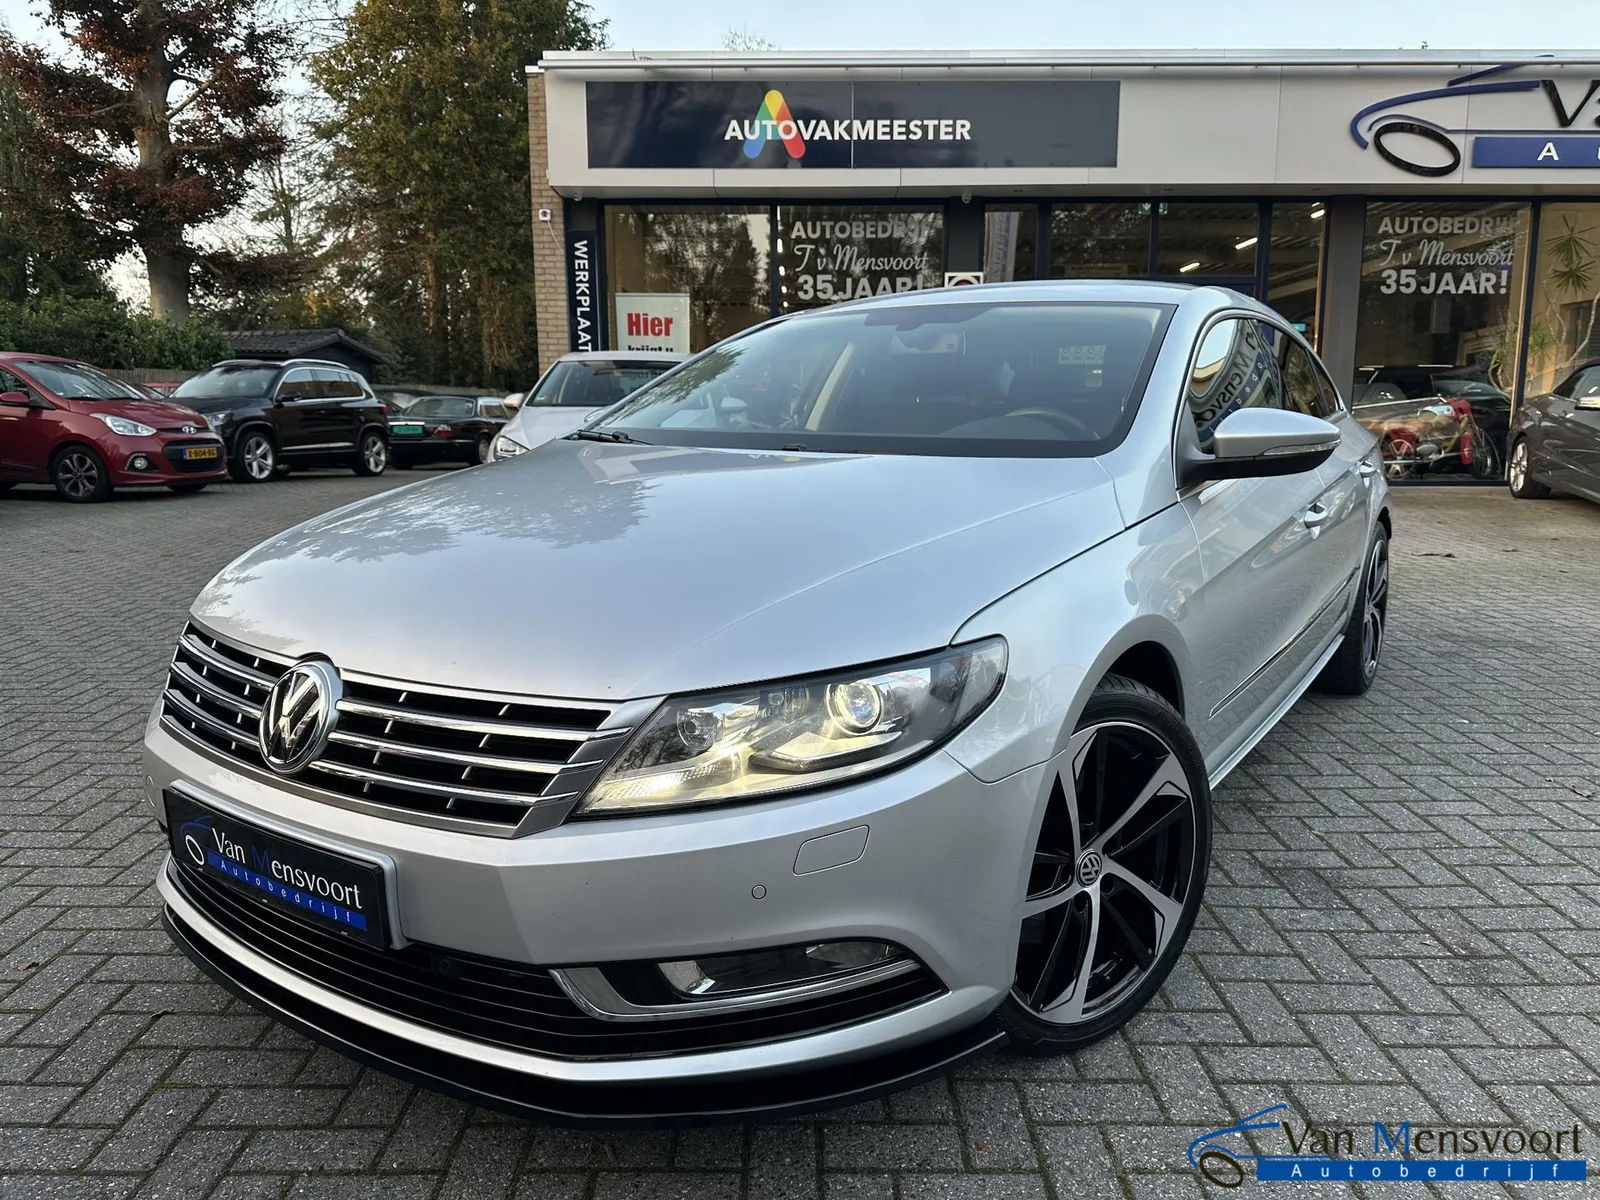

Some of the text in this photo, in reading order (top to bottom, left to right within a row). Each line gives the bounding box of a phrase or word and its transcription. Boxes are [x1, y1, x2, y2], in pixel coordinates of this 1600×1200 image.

[1540, 79, 1600, 128] V
[724, 119, 971, 141] AUTOVAKMEESTER
[833, 243, 929, 272] Mensvoort
[1418, 238, 1515, 266] Mensvoort
[1380, 268, 1509, 295] 35 JAAR!
[627, 312, 673, 337] Hier
[212, 827, 363, 909] Van Mensvoort
[220, 860, 351, 923] Autobedrijf
